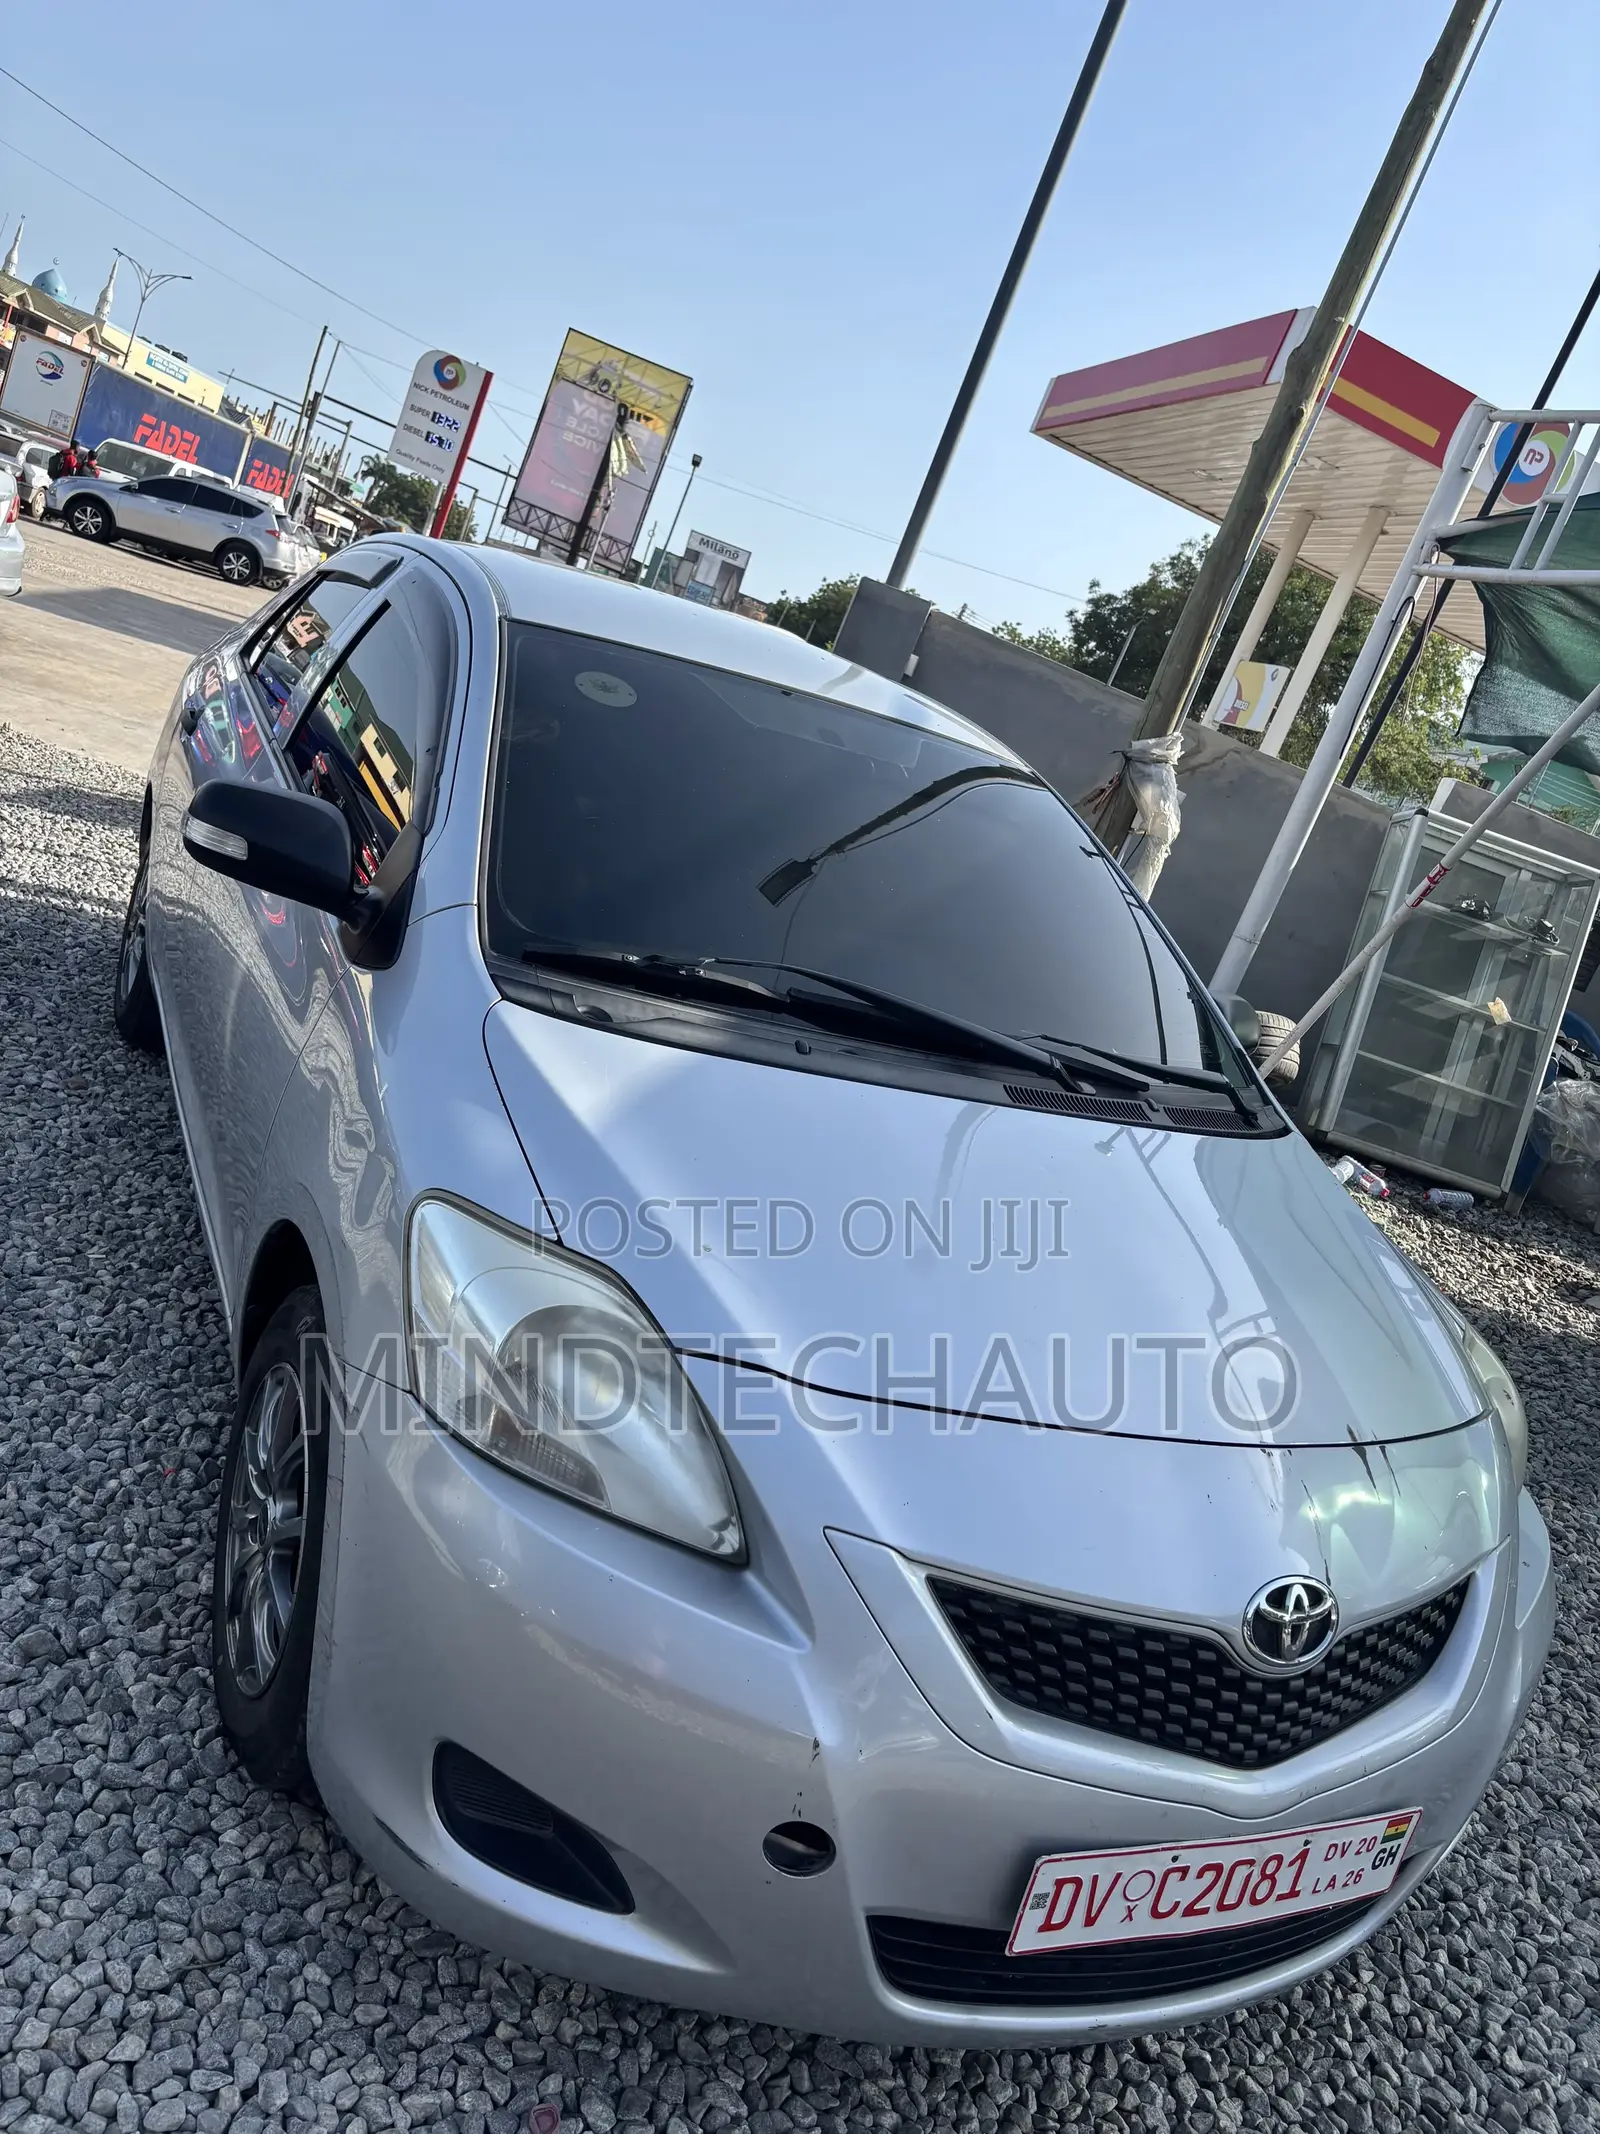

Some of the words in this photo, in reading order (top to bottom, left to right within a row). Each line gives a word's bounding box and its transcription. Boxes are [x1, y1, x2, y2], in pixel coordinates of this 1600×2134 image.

[36, 357, 64, 375] FADEL
[413, 382, 430, 394] NICK
[430, 389, 470, 411] PETROLEUM
[409, 404, 431, 417] SUPER
[133, 413, 200, 464] FADEL
[402, 423, 424, 438] DIESEL
[396, 449, 415, 462] Quality
[416, 456, 431, 469] Fuels
[432, 461, 445, 474] Only
[699, 537, 740, 560] Milano
[1323, 1839, 1354, 1861] DV
[1354, 1835, 1377, 1855] 20
[1372, 1844, 1400, 1870] GH
[1037, 1869, 1122, 1933] DV
[1149, 1847, 1310, 1920] C2081
[1311, 1876, 1337, 1894] LA
[1341, 1867, 1364, 1888] 26
